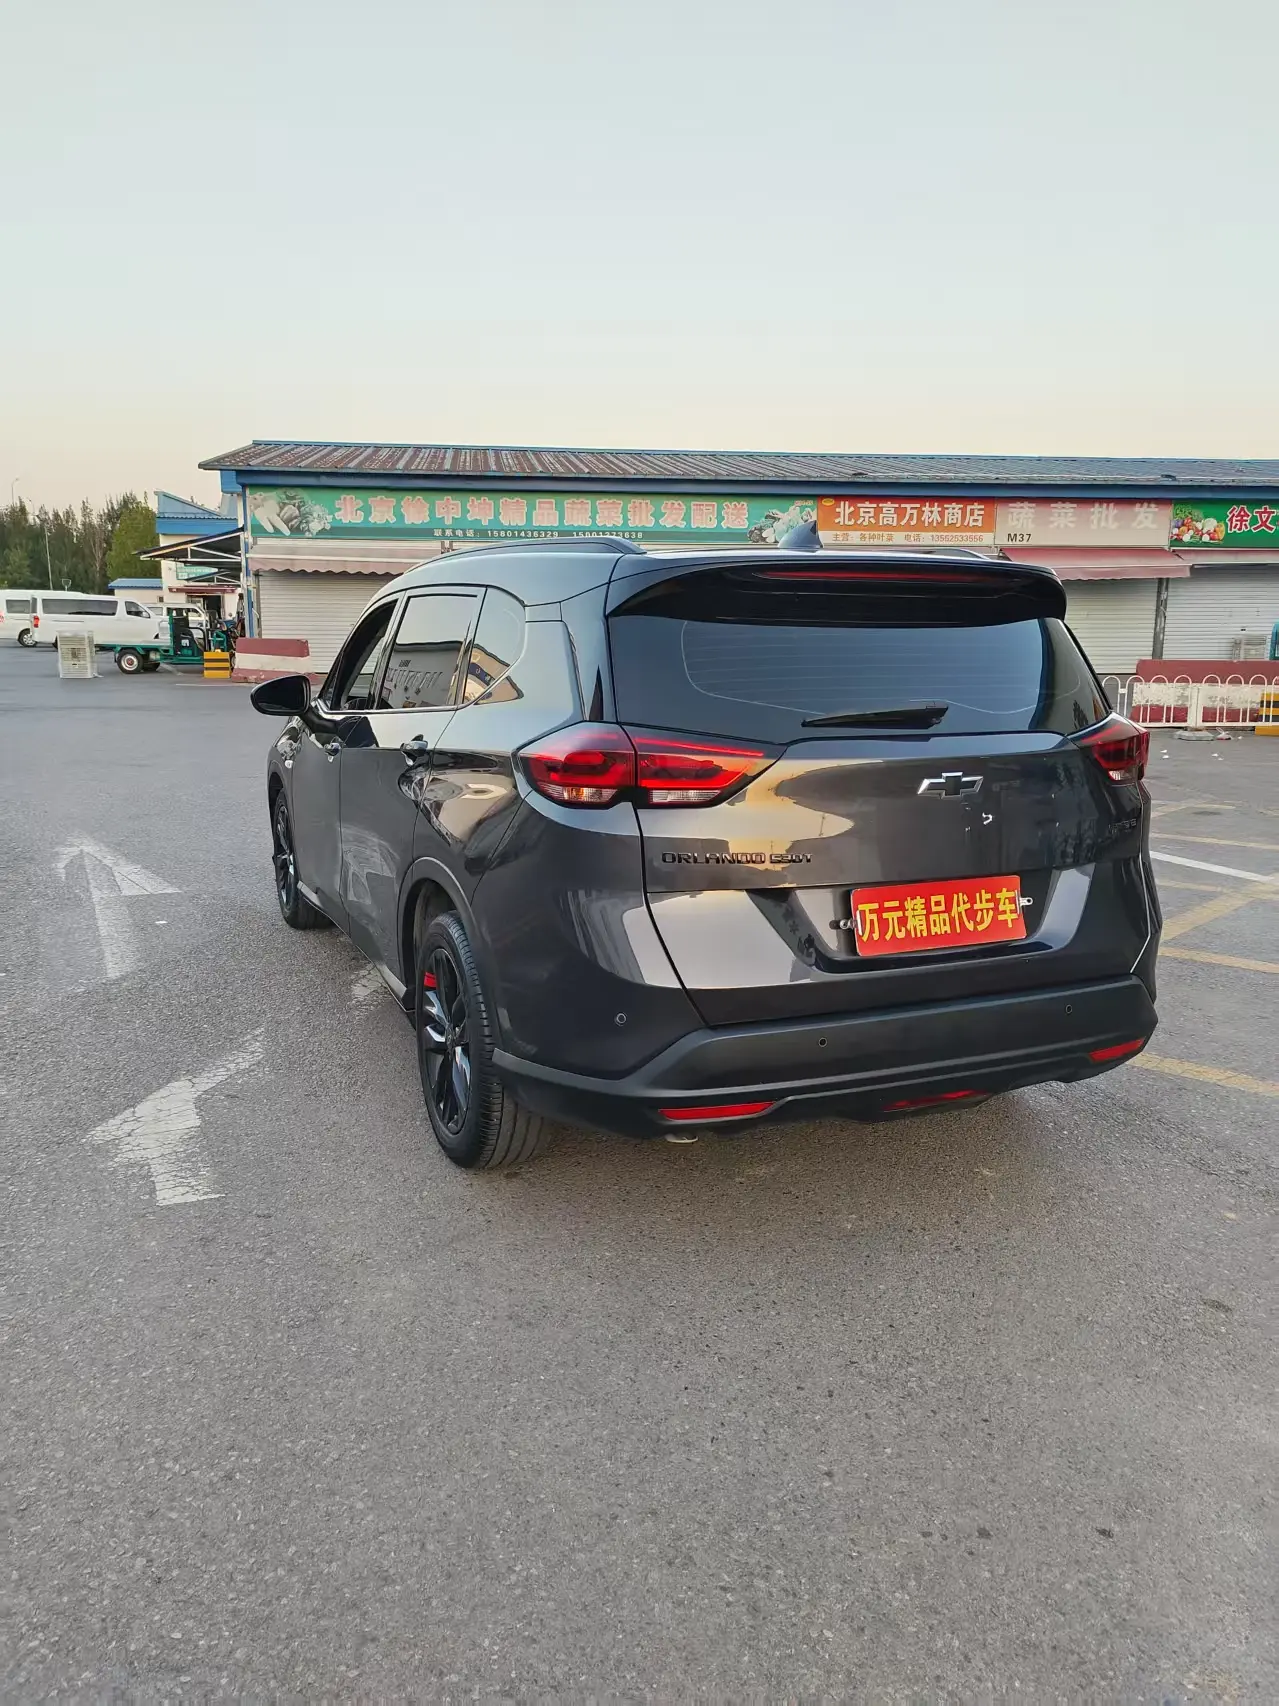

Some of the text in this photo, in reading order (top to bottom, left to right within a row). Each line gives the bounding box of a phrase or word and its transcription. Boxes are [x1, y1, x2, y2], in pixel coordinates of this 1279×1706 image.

[835, 501, 985, 527] 北京高万林商店
[1007, 502, 1159, 529] 蔬菜批发
[1226, 505, 1279, 533] 徐文
[487, 530, 559, 538] 15801436329
[1007, 533, 1032, 543] M37
[661, 852, 766, 865] ORLANDO
[857, 887, 1019, 943] 万元精品代步车
